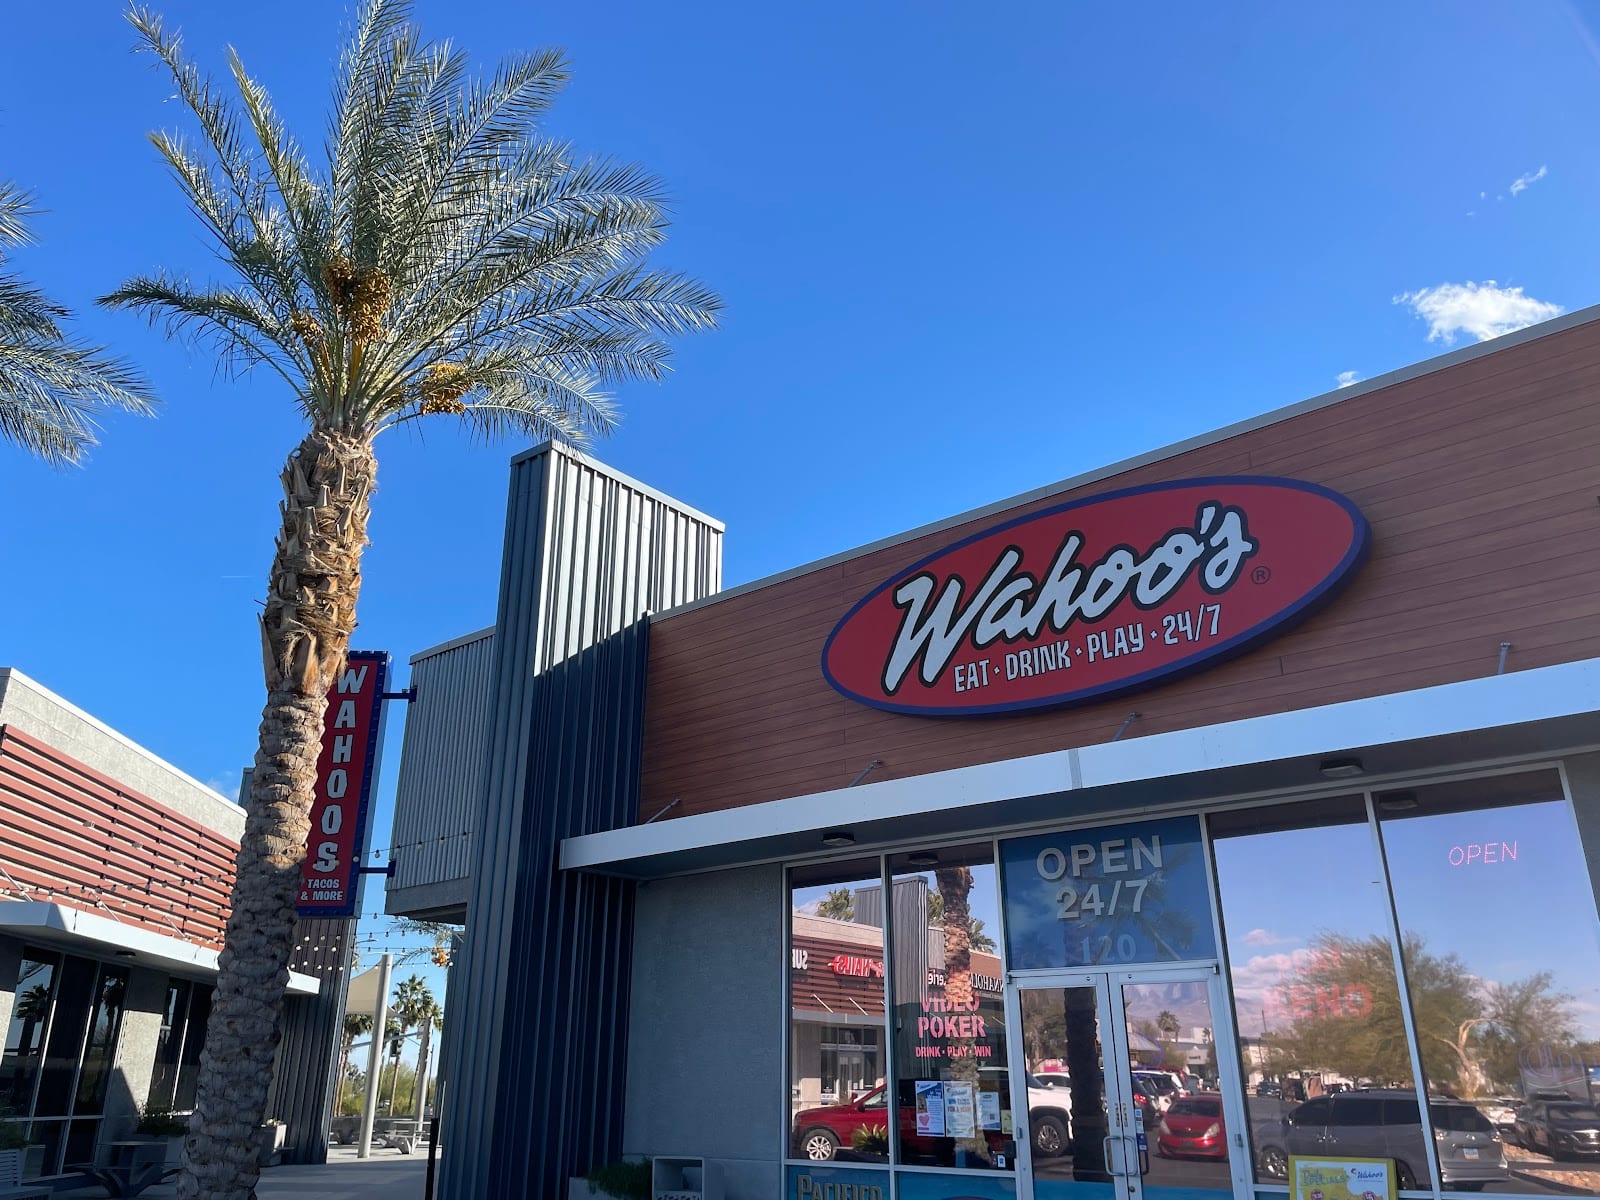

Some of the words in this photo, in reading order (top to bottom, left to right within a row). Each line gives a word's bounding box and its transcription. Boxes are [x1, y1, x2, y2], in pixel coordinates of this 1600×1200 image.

[881, 505, 1254, 692] Wahoo's
[954, 658, 990, 693] EAT
[1005, 640, 1072, 681] DRINK
[1086, 622, 1144, 662] PLAY
[1162, 603, 1221, 645] 24/7
[312, 664, 368, 873] WAHOOS
[1036, 835, 1163, 880] OPEN
[1449, 841, 1518, 866] OPEN
[300, 891, 308, 900] &
[312, 890, 344, 901] MORE
[307, 878, 340, 889] TACOS
[1056, 879, 1149, 920] 24/7
[1079, 934, 1137, 964] 120
[921, 991, 980, 1013] VIDEO
[1263, 983, 1373, 1018] KENO
[918, 1015, 986, 1038] POKER
[915, 1046, 941, 1057] DRINK
[947, 1045, 967, 1057] PLAY
[974, 1045, 992, 1057] WIN
